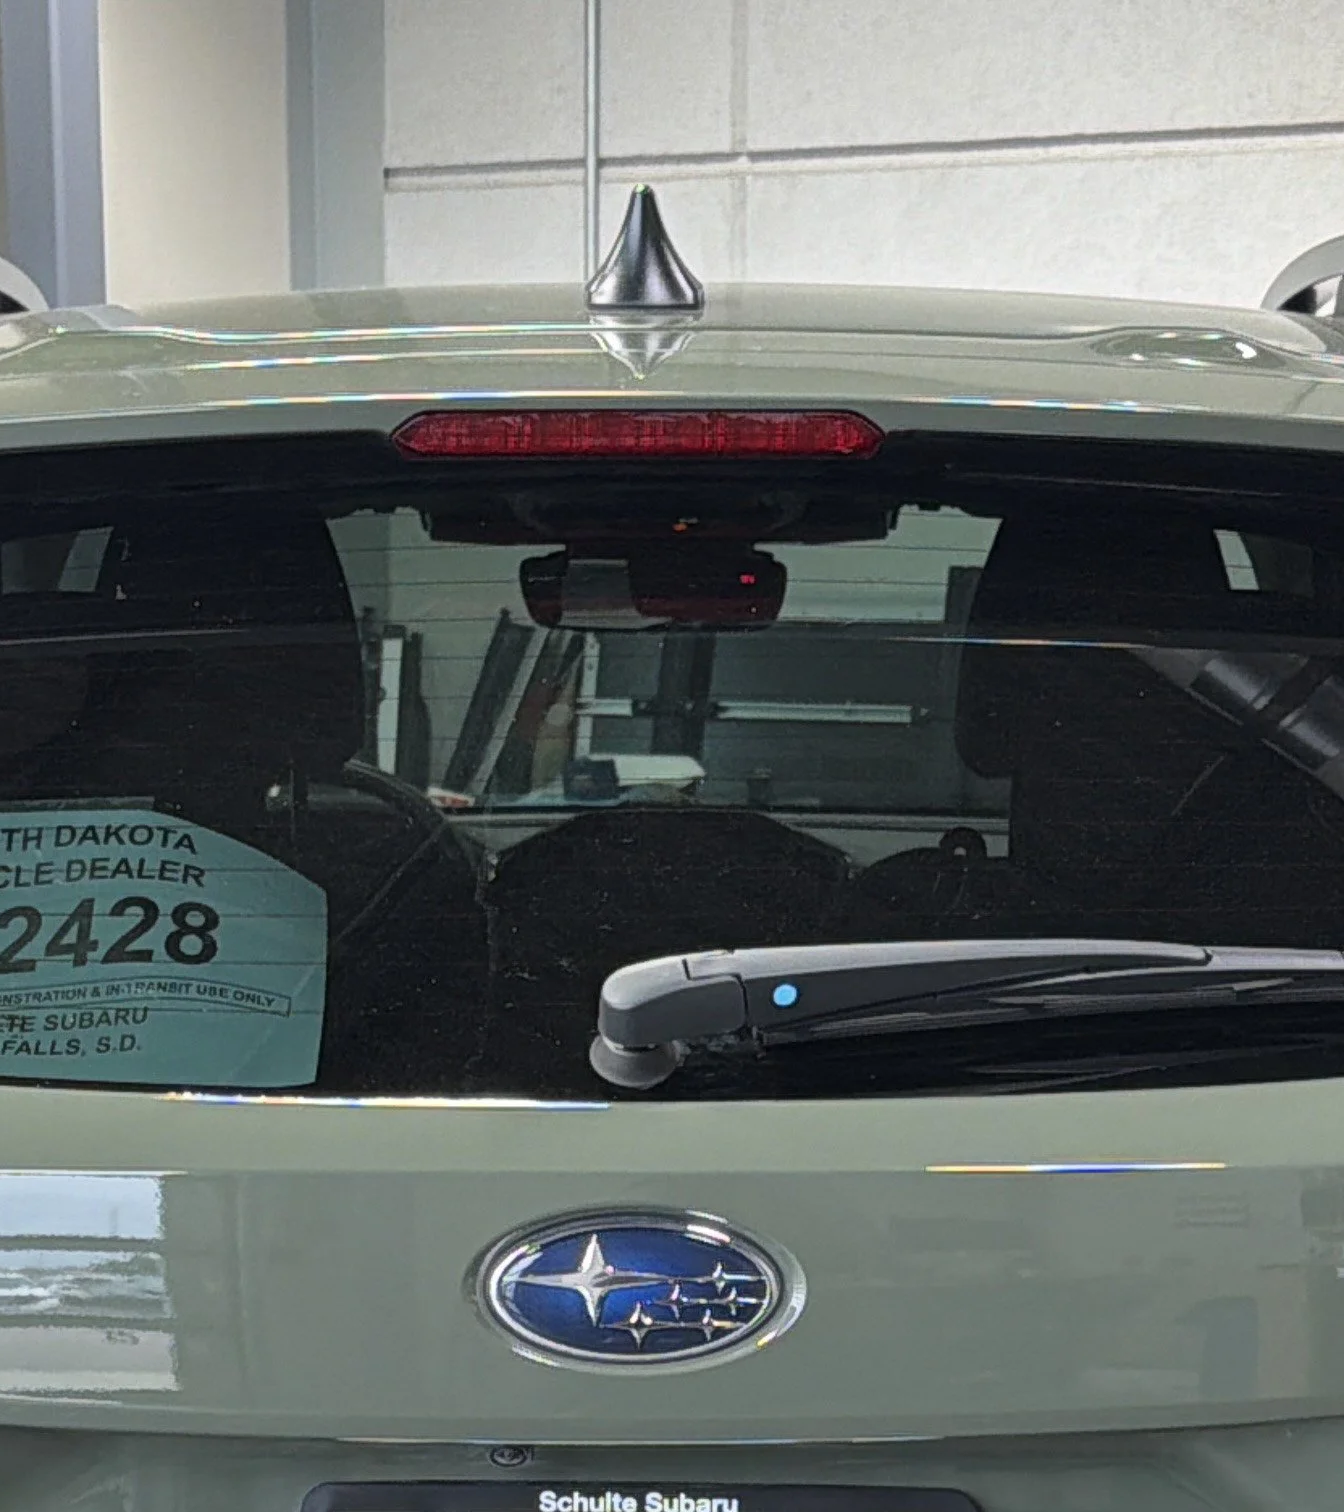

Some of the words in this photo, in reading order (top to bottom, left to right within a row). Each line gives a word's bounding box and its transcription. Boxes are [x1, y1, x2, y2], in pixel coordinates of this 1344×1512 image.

[54, 824, 198, 855] DAKOTA
[65, 857, 205, 888] DEALER
[89, 986, 102, 998] &
[196, 982, 229, 998] USE
[232, 989, 276, 1008] ONLY
[43, 1006, 149, 1032] SUBARU
[1, 1037, 86, 1057] FALLS,
[95, 1033, 142, 1055] S.D.
